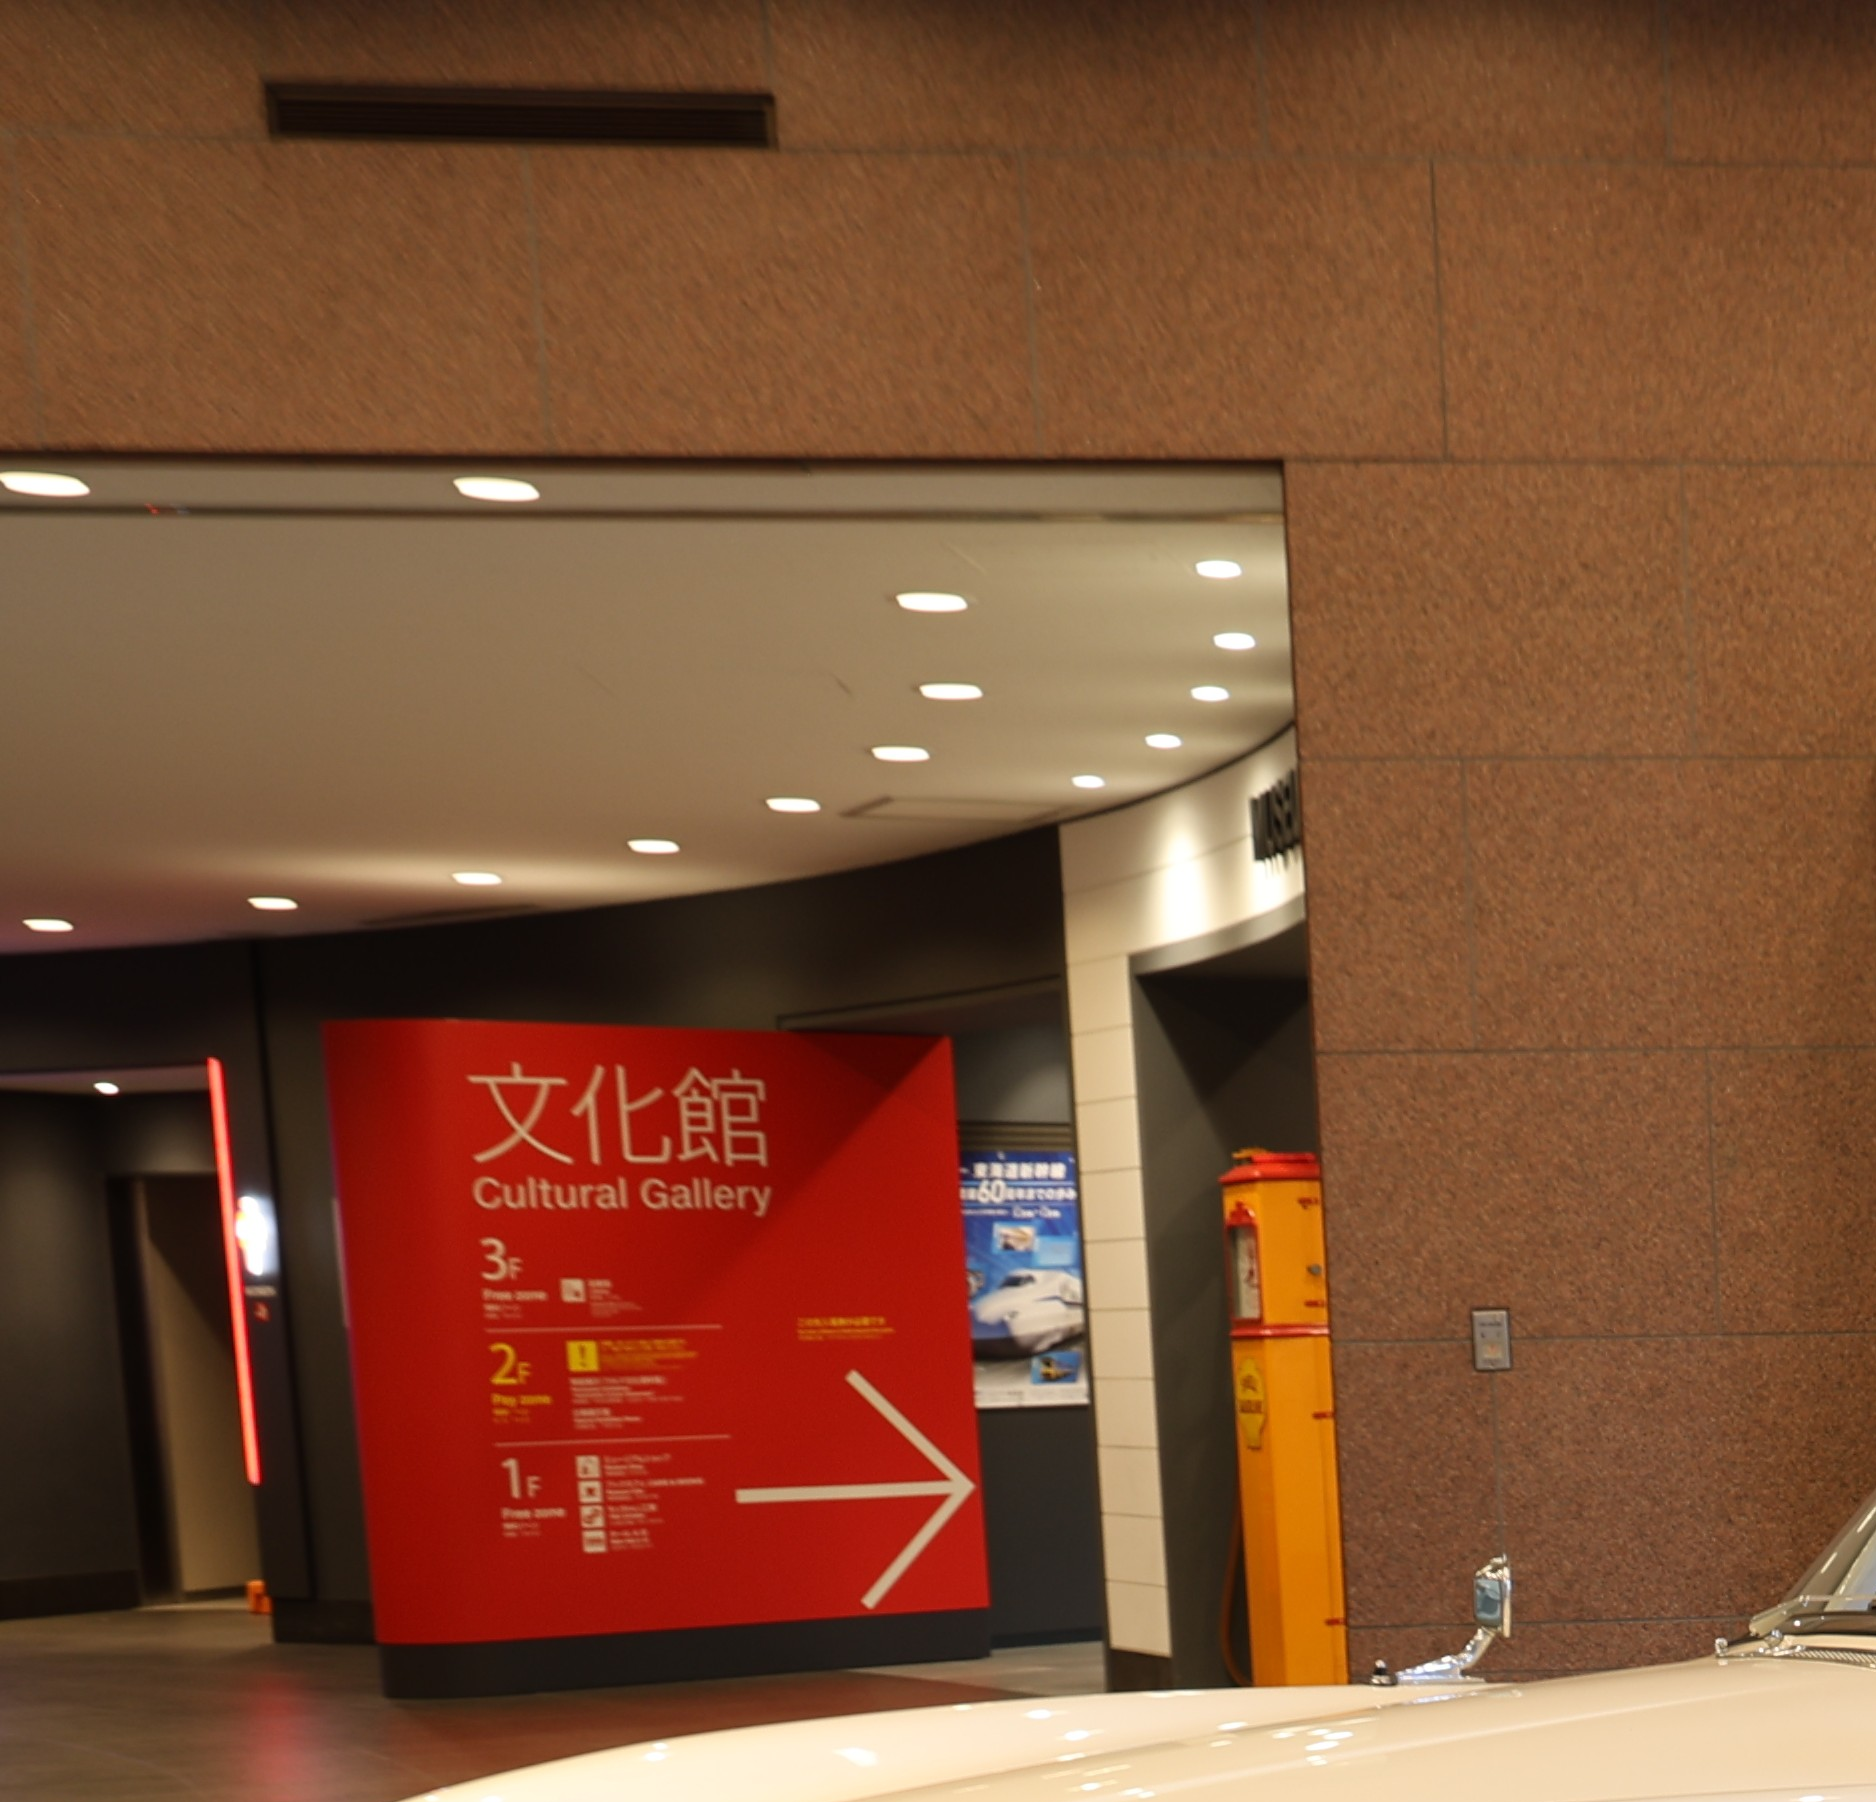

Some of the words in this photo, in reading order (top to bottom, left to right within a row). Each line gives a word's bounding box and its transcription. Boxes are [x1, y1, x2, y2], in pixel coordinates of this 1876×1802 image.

[467, 1062, 768, 1167] 文化館
[473, 1176, 629, 1209] Cultural
[640, 1178, 771, 1217] Gallery
[480, 1237, 523, 1281] 3F
[490, 1343, 531, 1385] 2F
[502, 1458, 541, 1499] 1F
